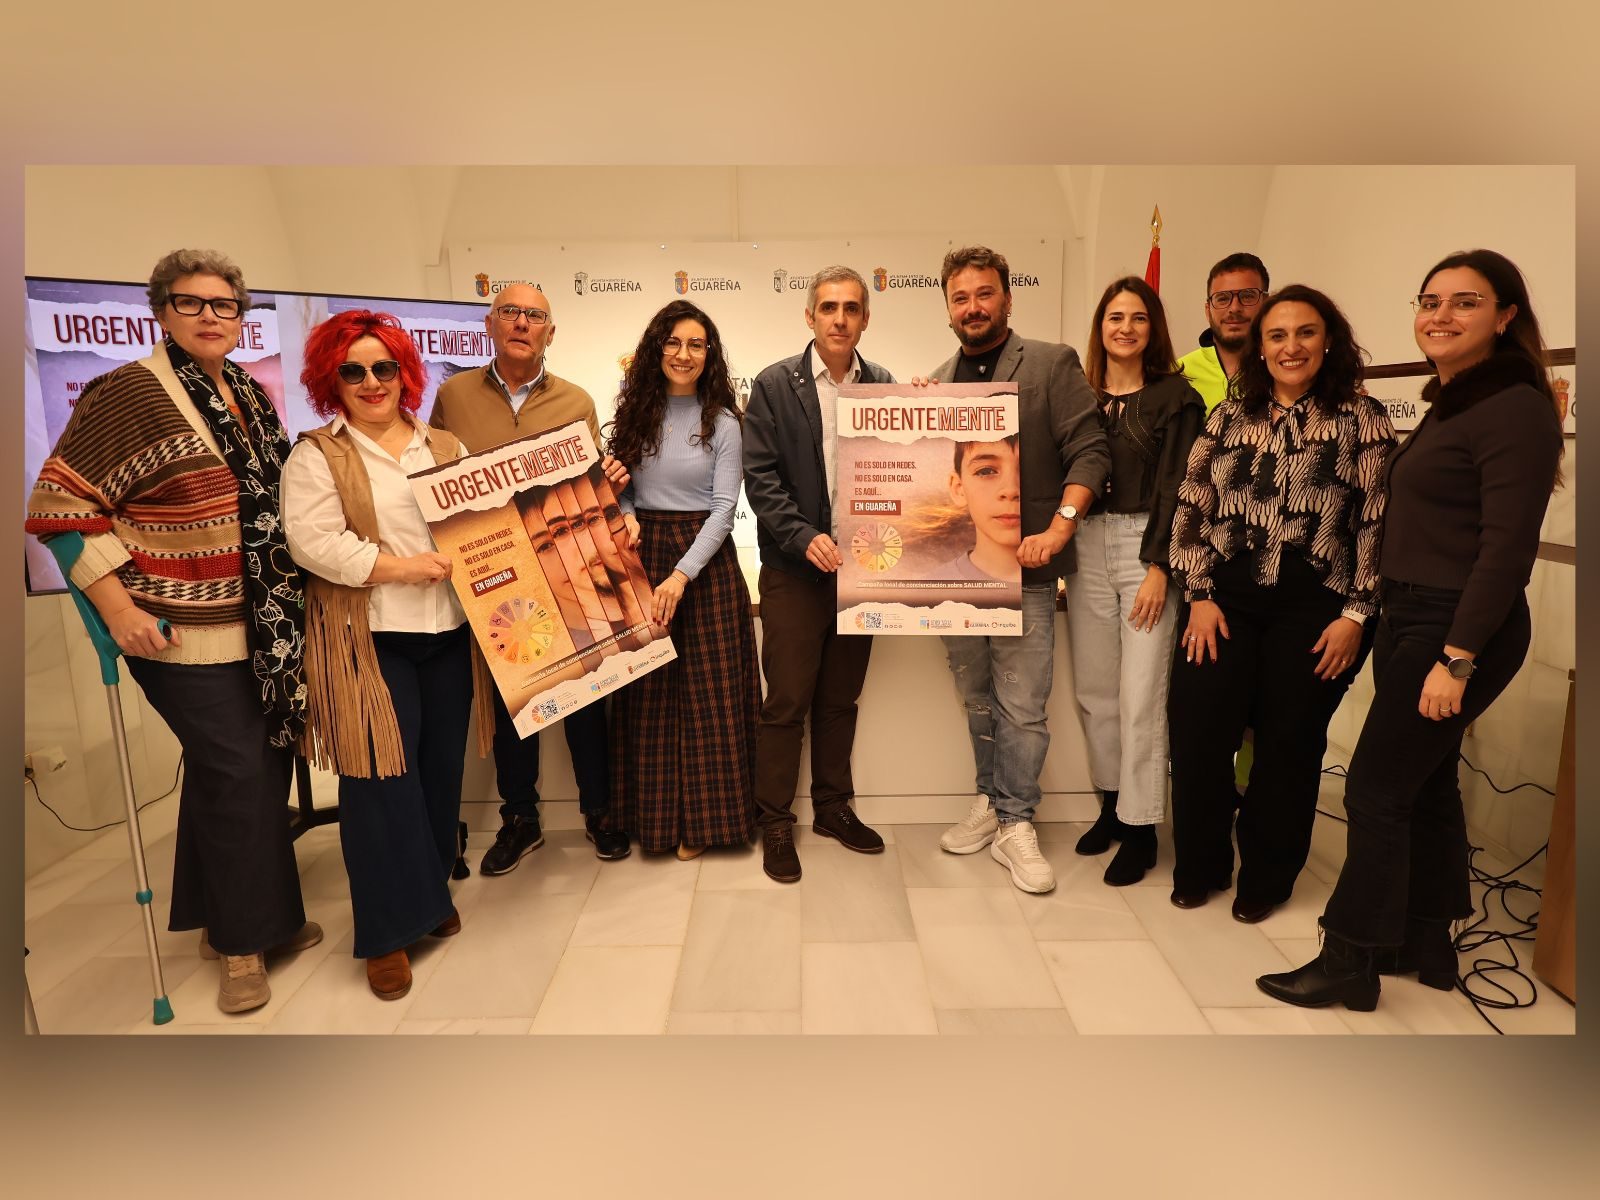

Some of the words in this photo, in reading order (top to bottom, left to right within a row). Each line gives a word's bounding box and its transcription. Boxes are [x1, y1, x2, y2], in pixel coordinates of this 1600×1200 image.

[690, 280, 741, 291] GUAREÑA
[889, 277, 939, 288] GUAREÑA
[1008, 275, 1039, 286] REÑA
[590, 281, 641, 292] GUAREÑA
[67, 382, 78, 391] NO
[1385, 401, 1416, 418] REÑA
[852, 407, 1006, 431] URGENTEMENTE
[855, 461, 863, 469] NO
[864, 461, 871, 469] ES
[872, 461, 887, 469] SOLO
[888, 461, 896, 469] EN
[896, 461, 916, 469] REDES.
[431, 435, 588, 510] URGENTEMENTE
[855, 474, 863, 482] NO
[864, 474, 871, 482] ES
[872, 474, 887, 482] SOLO
[888, 474, 896, 482] EN
[897, 474, 913, 482] CASA.
[855, 502, 863, 511] EN
[865, 501, 897, 511] GUAREÑA
[459, 545, 467, 553] NO
[467, 542, 475, 550] ES
[475, 537, 488, 547] SOLO
[464, 557, 473, 565] NO
[472, 554, 480, 562] ES
[480, 549, 493, 559] SOLO
[475, 582, 485, 592] EN
[485, 571, 513, 587] GUAREÑA
[615, 629, 631, 639] SALUD
